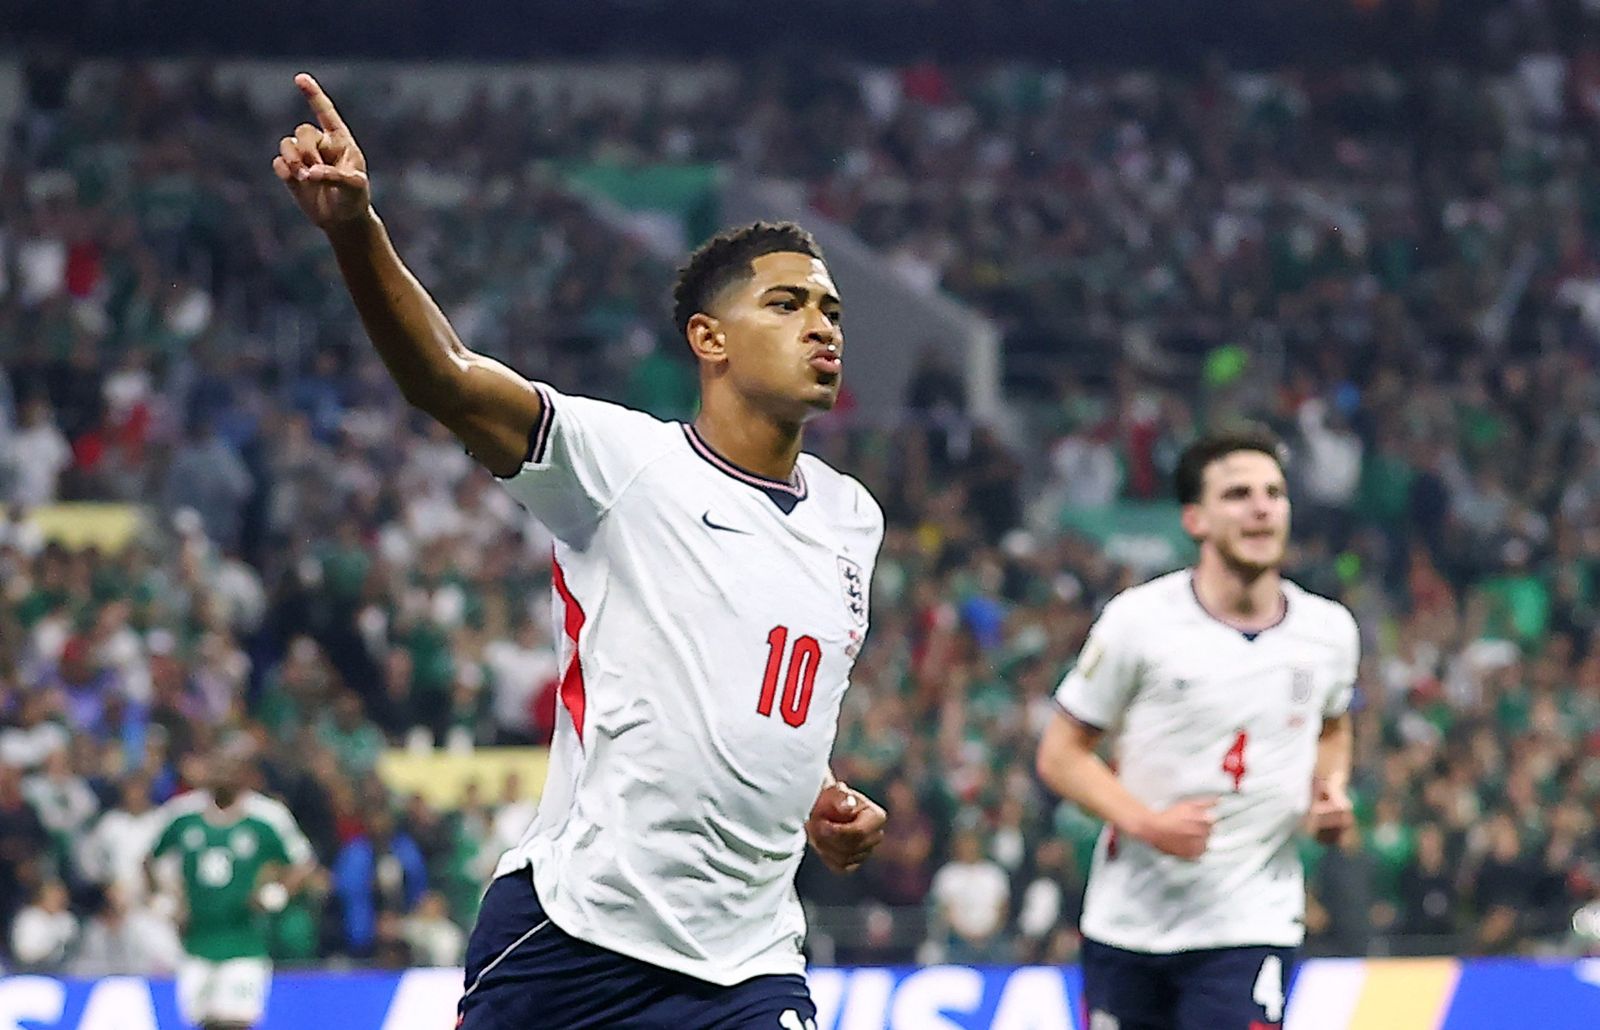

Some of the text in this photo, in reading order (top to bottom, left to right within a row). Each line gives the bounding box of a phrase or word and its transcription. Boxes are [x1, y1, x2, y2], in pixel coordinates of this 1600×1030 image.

[756, 624, 822, 729] 10
[1221, 728, 1248, 793] 4
[1252, 954, 1286, 1023] 4
